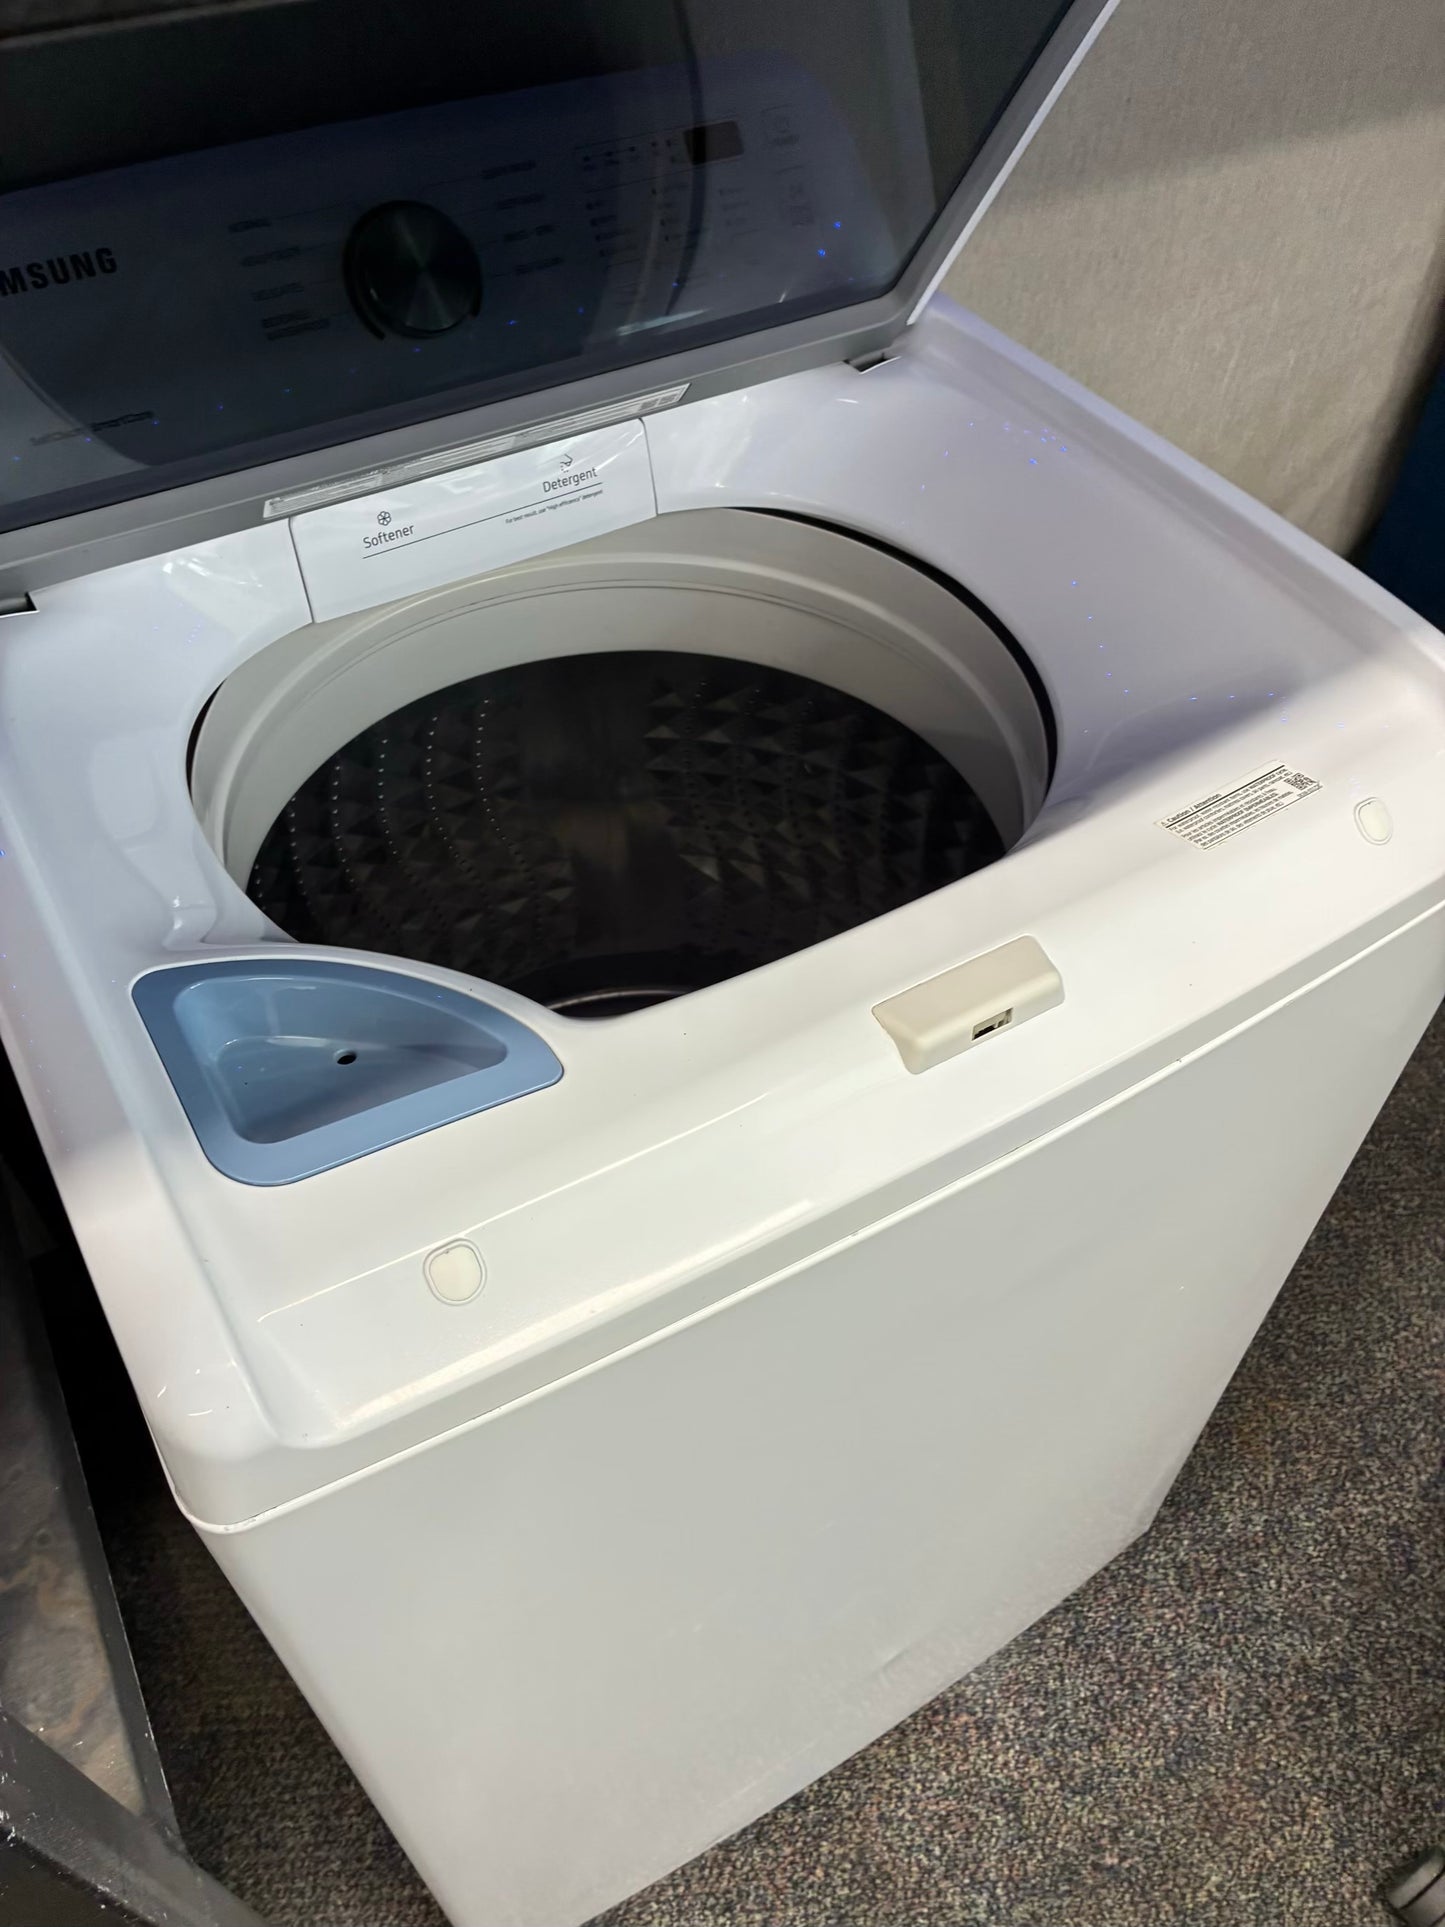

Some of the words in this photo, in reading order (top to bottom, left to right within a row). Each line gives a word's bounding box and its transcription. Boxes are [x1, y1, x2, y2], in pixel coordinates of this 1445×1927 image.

[542, 467, 598, 493] Detergent
[362, 525, 415, 549] Softener
[1166, 809, 1191, 823] Caution
[1193, 793, 1222, 809] Attention
